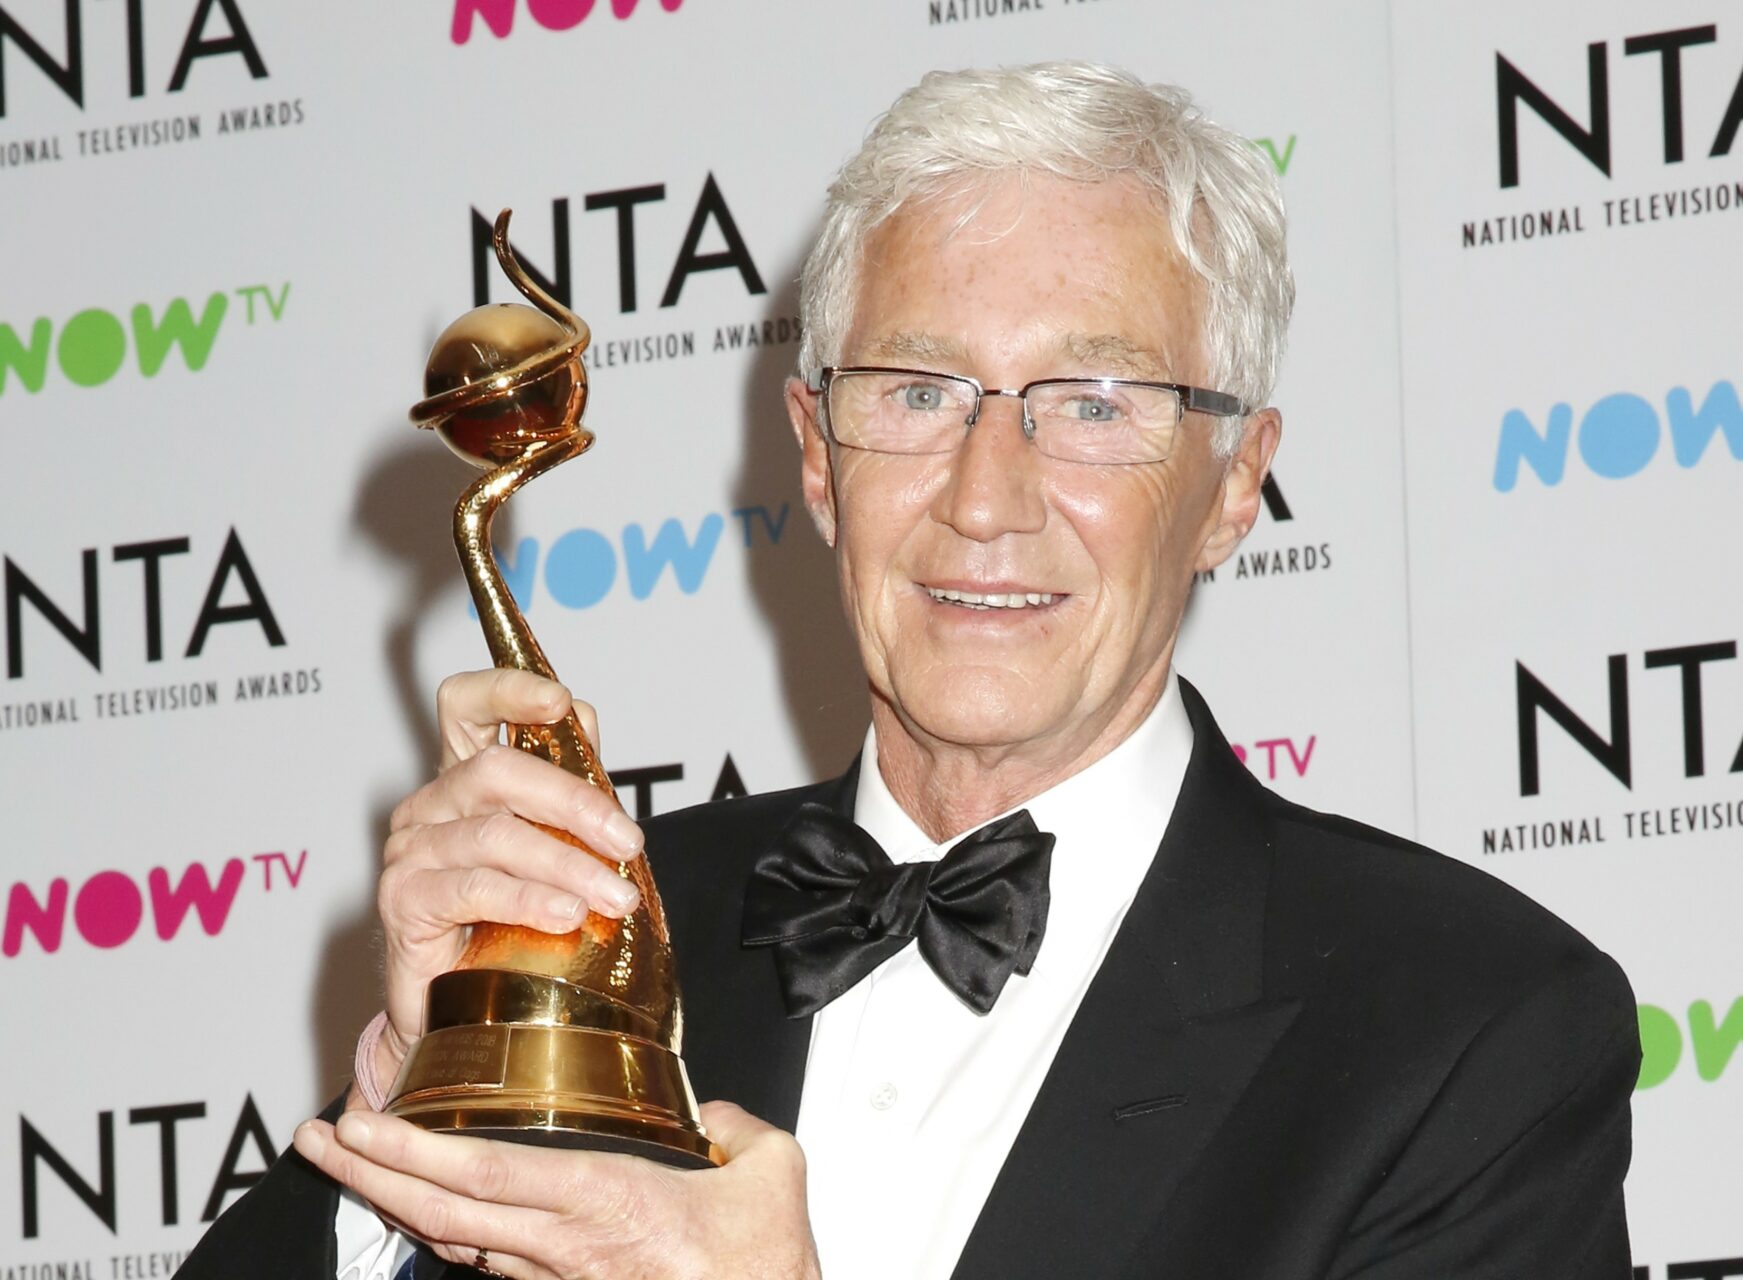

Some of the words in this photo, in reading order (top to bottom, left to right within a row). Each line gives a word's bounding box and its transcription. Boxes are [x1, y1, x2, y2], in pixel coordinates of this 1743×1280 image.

[0, 135, 63, 168] IONAL
[77, 115, 201, 157] TELEVISION
[217, 98, 306, 135] AWARDS
[470, 169, 769, 314] NTA
[1462, 206, 1585, 249] NATIONAL
[0, 291, 229, 397] NOW
[235, 281, 291, 326] TV
[583, 330, 695, 370] LEVISION
[731, 502, 790, 549] TV
[1235, 543, 1333, 580] AWARDS
[4, 524, 288, 680] NTA
[0, 697, 80, 731] TIONAL
[95, 681, 219, 719] TELEVISION
[235, 668, 323, 701] AWARDS
[1515, 639, 1743, 798] NT
[1254, 734, 1317, 781] TV
[1482, 816, 1606, 856] NATIONAL
[2, 857, 246, 958] NOW
[252, 849, 308, 892] TV
[20, 1090, 281, 1240] NTA
